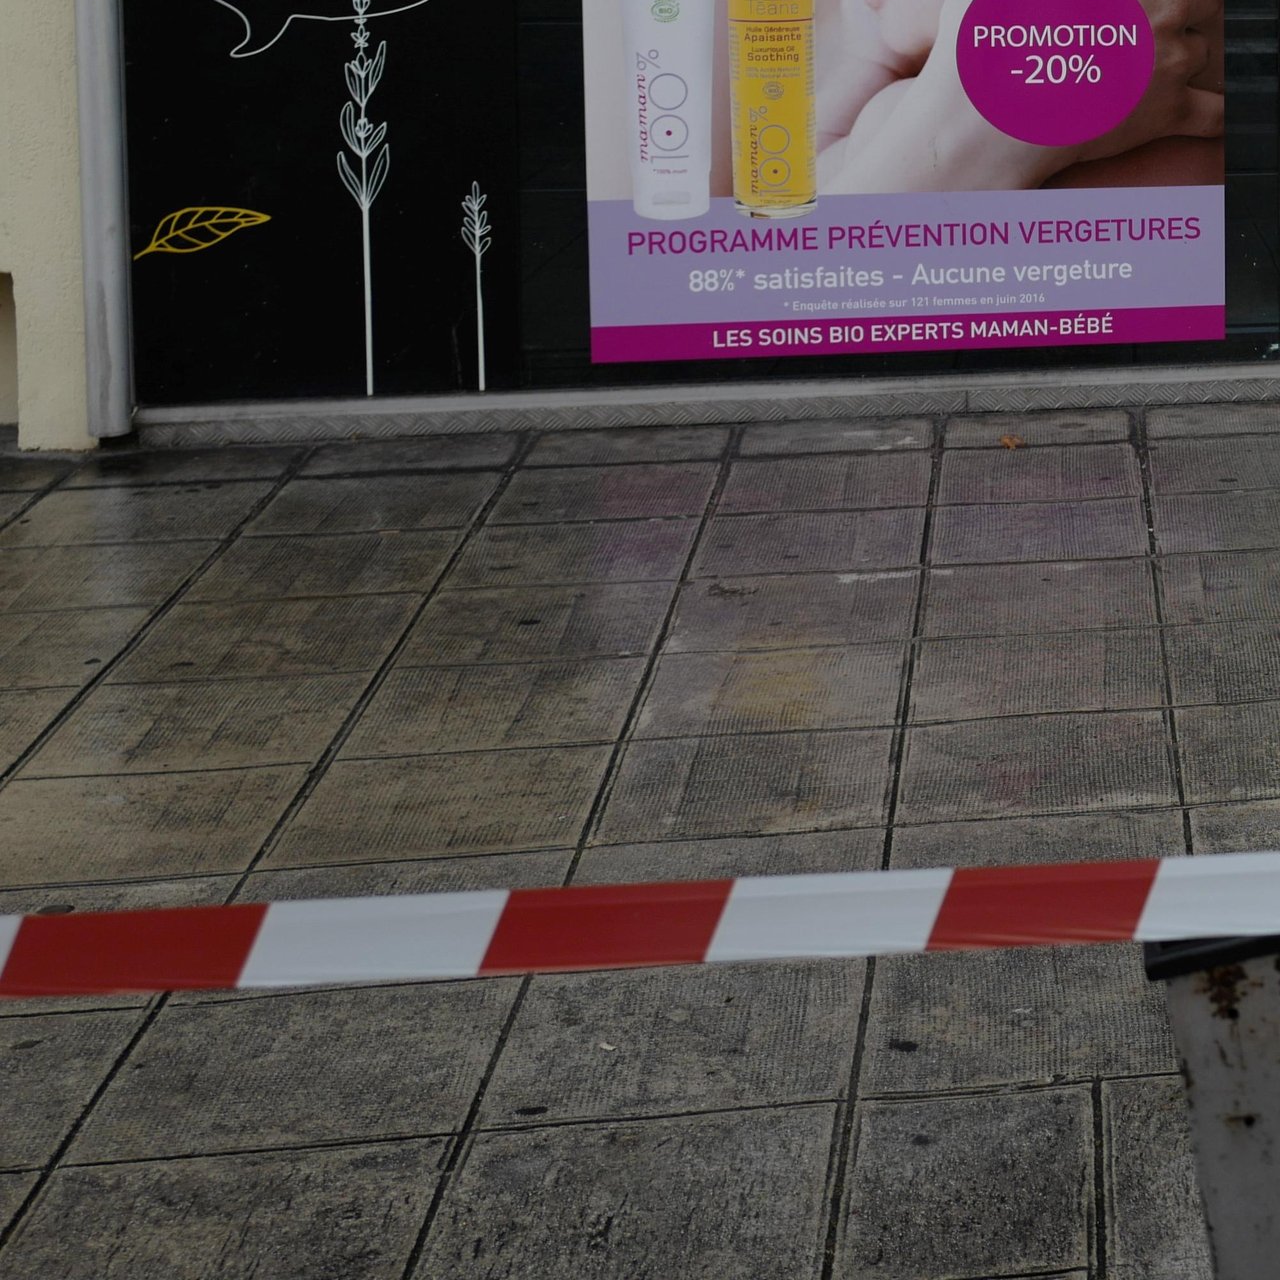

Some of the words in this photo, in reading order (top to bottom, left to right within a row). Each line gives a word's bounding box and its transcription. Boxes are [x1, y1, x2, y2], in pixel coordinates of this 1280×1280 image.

[744, 33, 802, 43] Apaisante
[973, 24, 1138, 48] PROMOTION
[747, 52, 799, 62] Soothing
[1010, 54, 1102, 85] -20%
[627, 226, 819, 256] PROGRAMME
[828, 220, 1009, 250] PRÉVENTION
[1018, 216, 1201, 245] VERGETURES
[754, 266, 885, 291] satisfaites
[911, 263, 1006, 286] Aucune
[1013, 259, 1133, 287] vergeture
[792, 300, 838, 312] Enquête
[841, 298, 887, 310] réalisée
[889, 300, 908, 309] sur
[911, 296, 930, 308] 121
[933, 295, 977, 307] femmes
[980, 295, 993, 306] en
[996, 293, 1017, 308] juin
[1019, 292, 1045, 304] 2016
[713, 329, 753, 348] LES
[758, 326, 823, 346] SOINS
[829, 325, 864, 344] BIO
[871, 321, 964, 342] EXPERTS
[970, 312, 1114, 338] MAMAN-BÉBÉ
